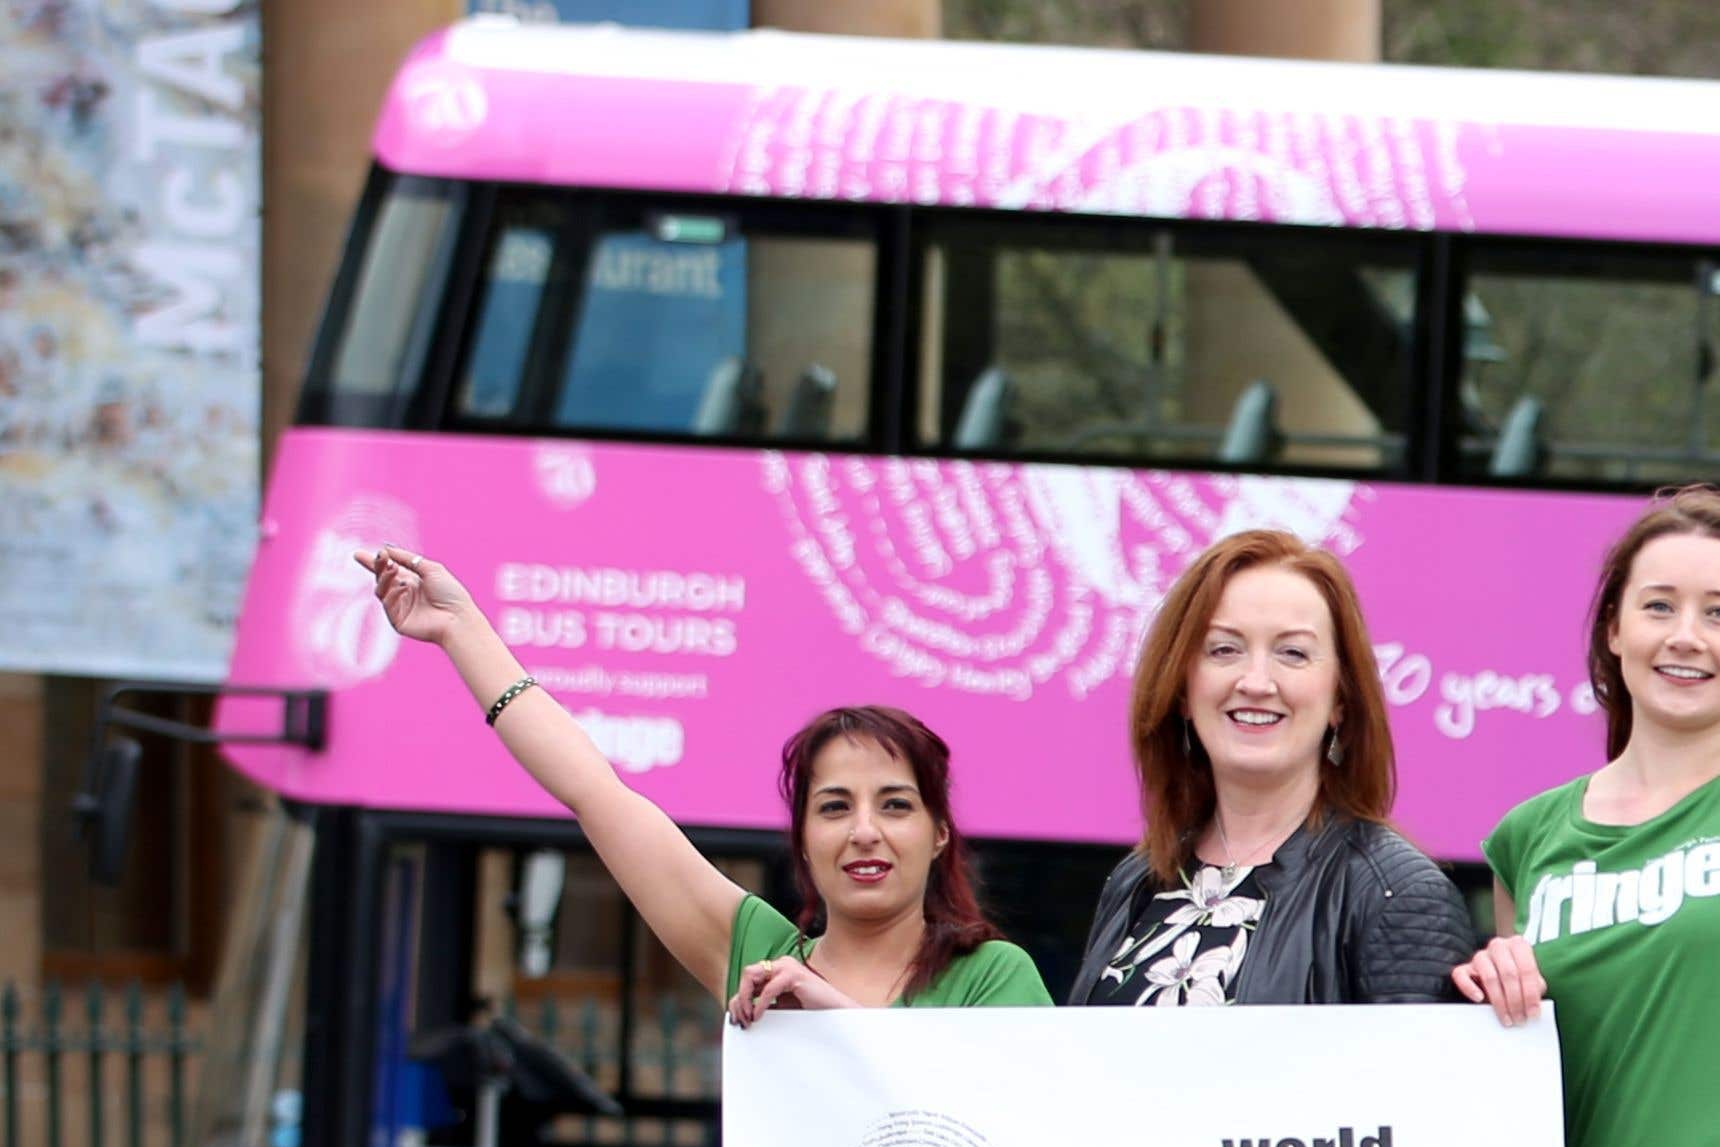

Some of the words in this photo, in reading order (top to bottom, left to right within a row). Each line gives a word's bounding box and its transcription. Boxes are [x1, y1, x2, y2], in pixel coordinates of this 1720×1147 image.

[137, 0, 249, 347] McTA
[497, 562, 746, 613] EDINBURGH
[500, 606, 588, 650] BUS
[594, 611, 738, 657] TOURS
[1433, 669, 1561, 739] years
